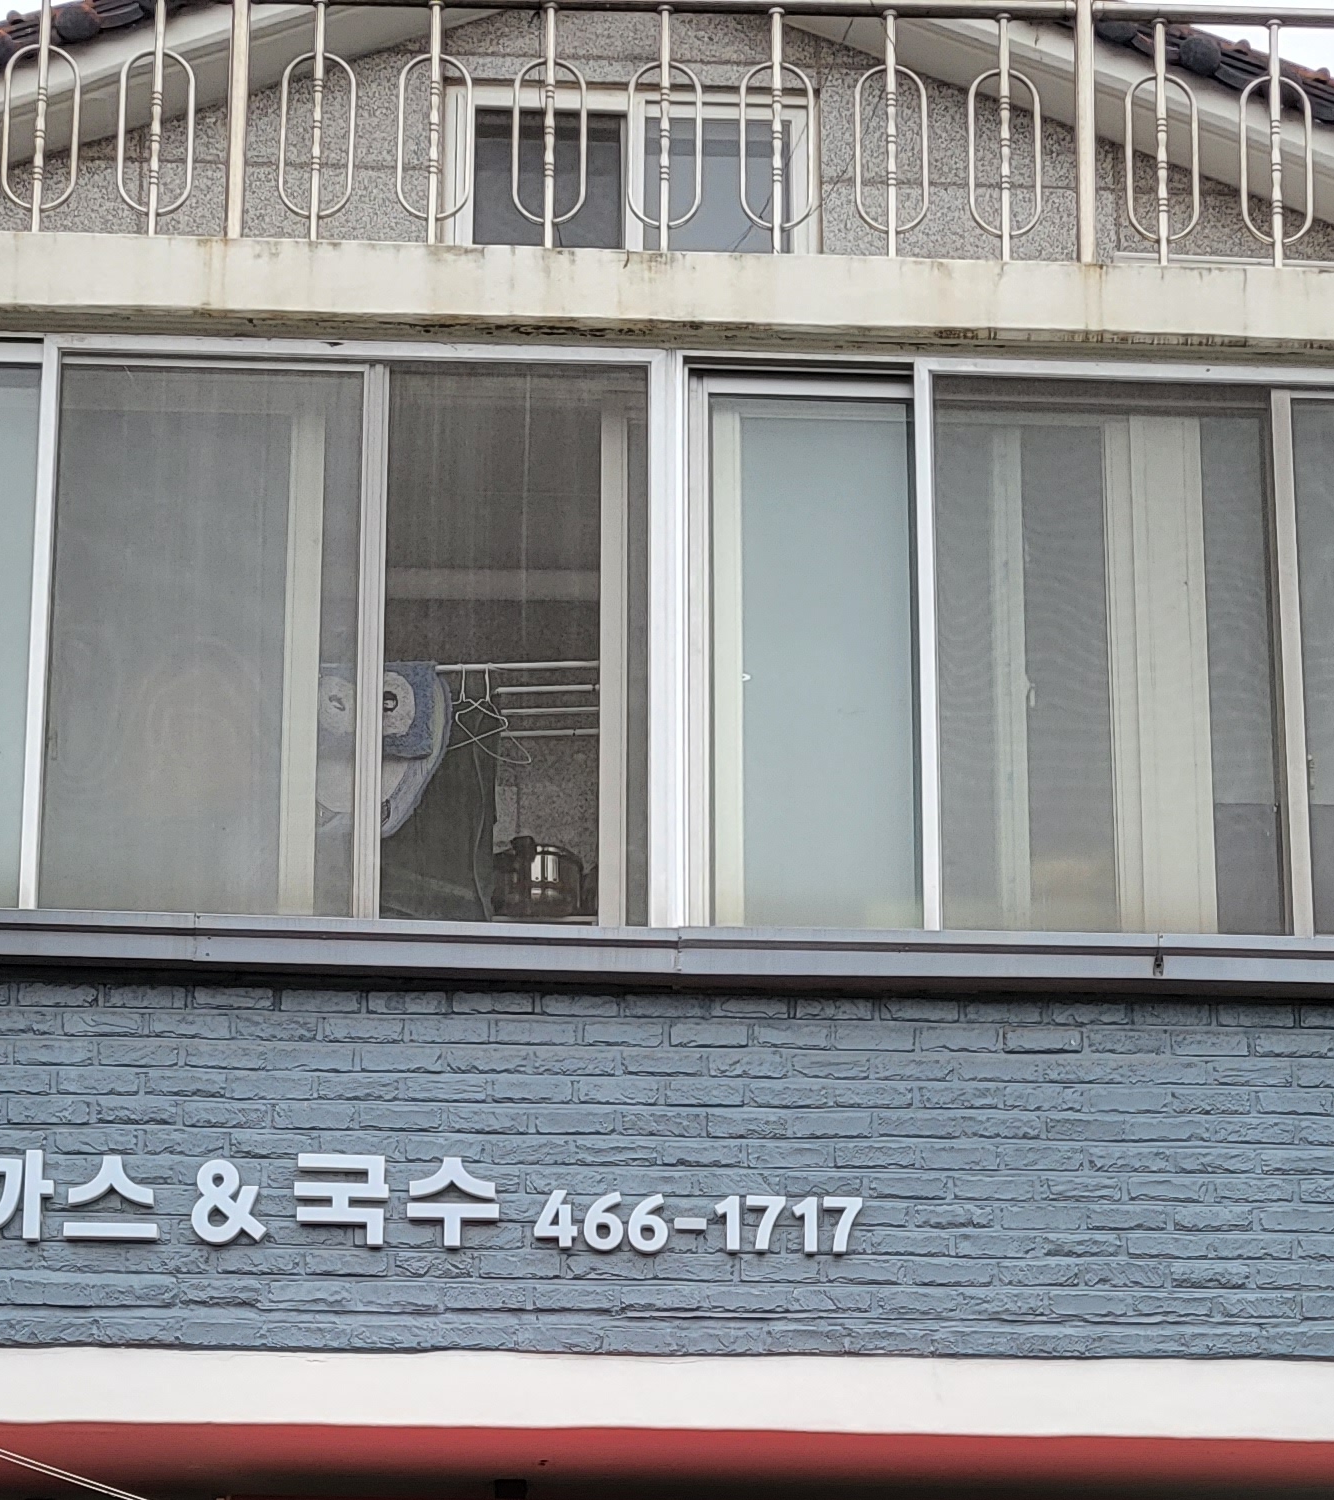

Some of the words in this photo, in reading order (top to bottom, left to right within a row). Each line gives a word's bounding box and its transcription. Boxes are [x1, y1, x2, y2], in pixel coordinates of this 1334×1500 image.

[190, 1158, 268, 1246] &
[293, 1152, 501, 1249] 국수
[533, 1189, 864, 1256] 466-1717
